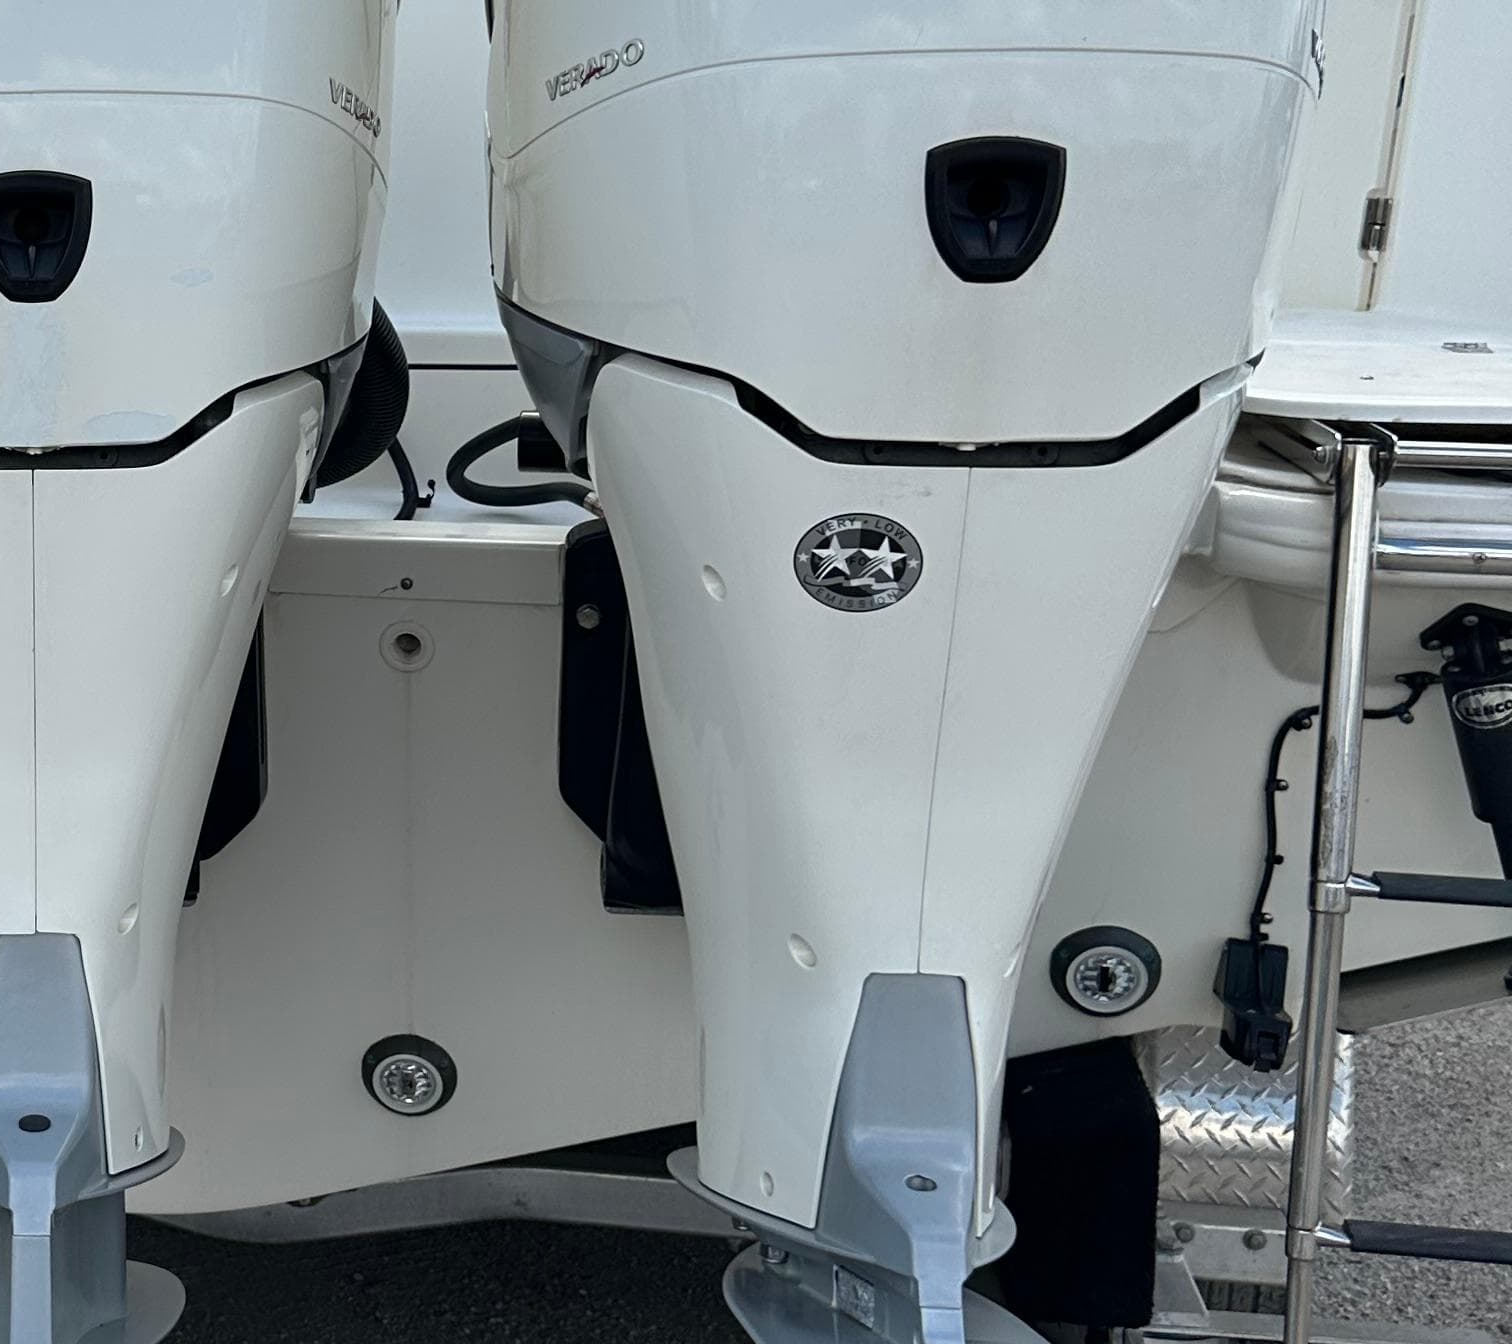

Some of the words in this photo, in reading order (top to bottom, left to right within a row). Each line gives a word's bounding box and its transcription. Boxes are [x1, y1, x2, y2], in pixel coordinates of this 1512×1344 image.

[546, 38, 645, 102] VERADO
[816, 517, 857, 536] VERY
[874, 518, 908, 541] LOW
[815, 587, 899, 609] EMISSION
